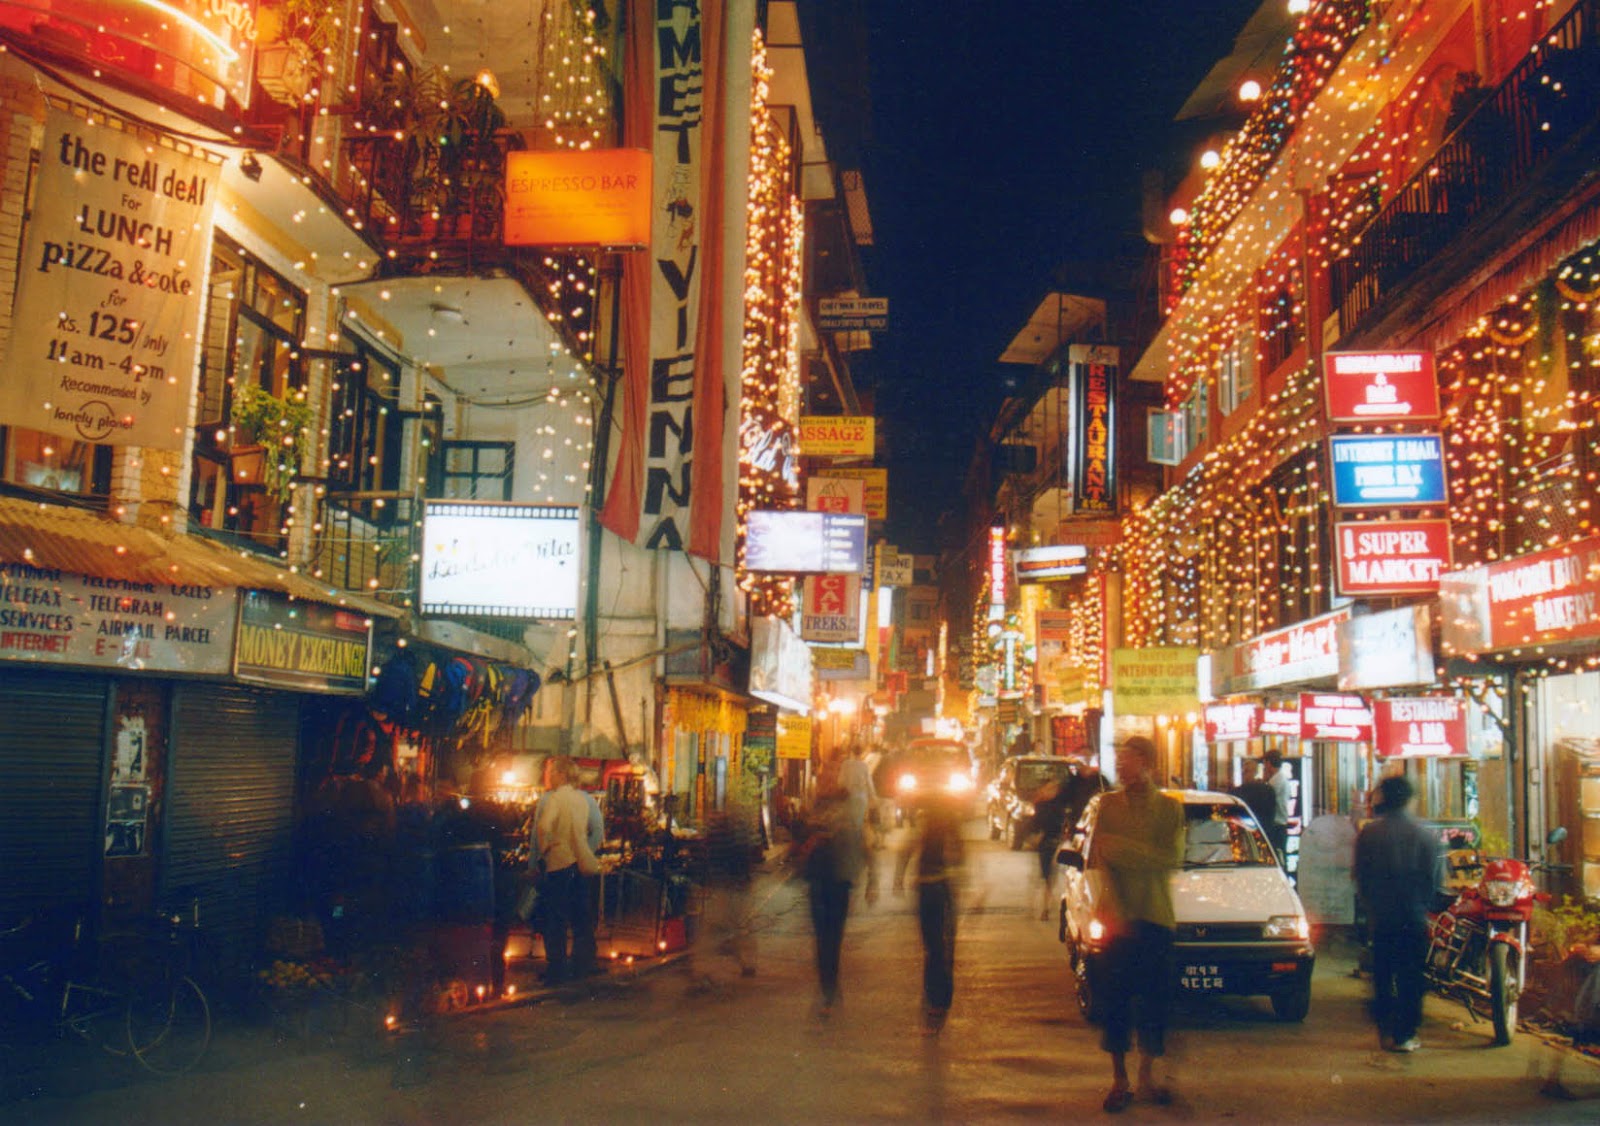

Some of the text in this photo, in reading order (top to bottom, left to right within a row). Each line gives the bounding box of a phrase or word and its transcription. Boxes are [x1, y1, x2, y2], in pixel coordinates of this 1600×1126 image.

[59, 133, 106, 177] the
[511, 175, 637, 194] ESPRESSO BAR
[79, 205, 173, 256] LUNCH
[644, 245, 697, 550] VIENNA
[54, 406, 93, 428] lonely
[799, 426, 865, 441] ASSAGE
[1087, 362, 1107, 500] RESTAURANT
[1358, 531, 1429, 555] SUPER
[1348, 558, 1442, 583] MARKET
[90, 595, 163, 617] TELEGRAM
[1533, 592, 1595, 632] BAKERY
[0, 610, 73, 631] SERVICES
[97, 619, 155, 639] AIRMAIL
[165, 625, 210, 644] PARCEL
[805, 615, 848, 630] TREKS
[1, 631, 71, 653] INTERNET
[239, 624, 366, 678] MONEY EXCHANGE
